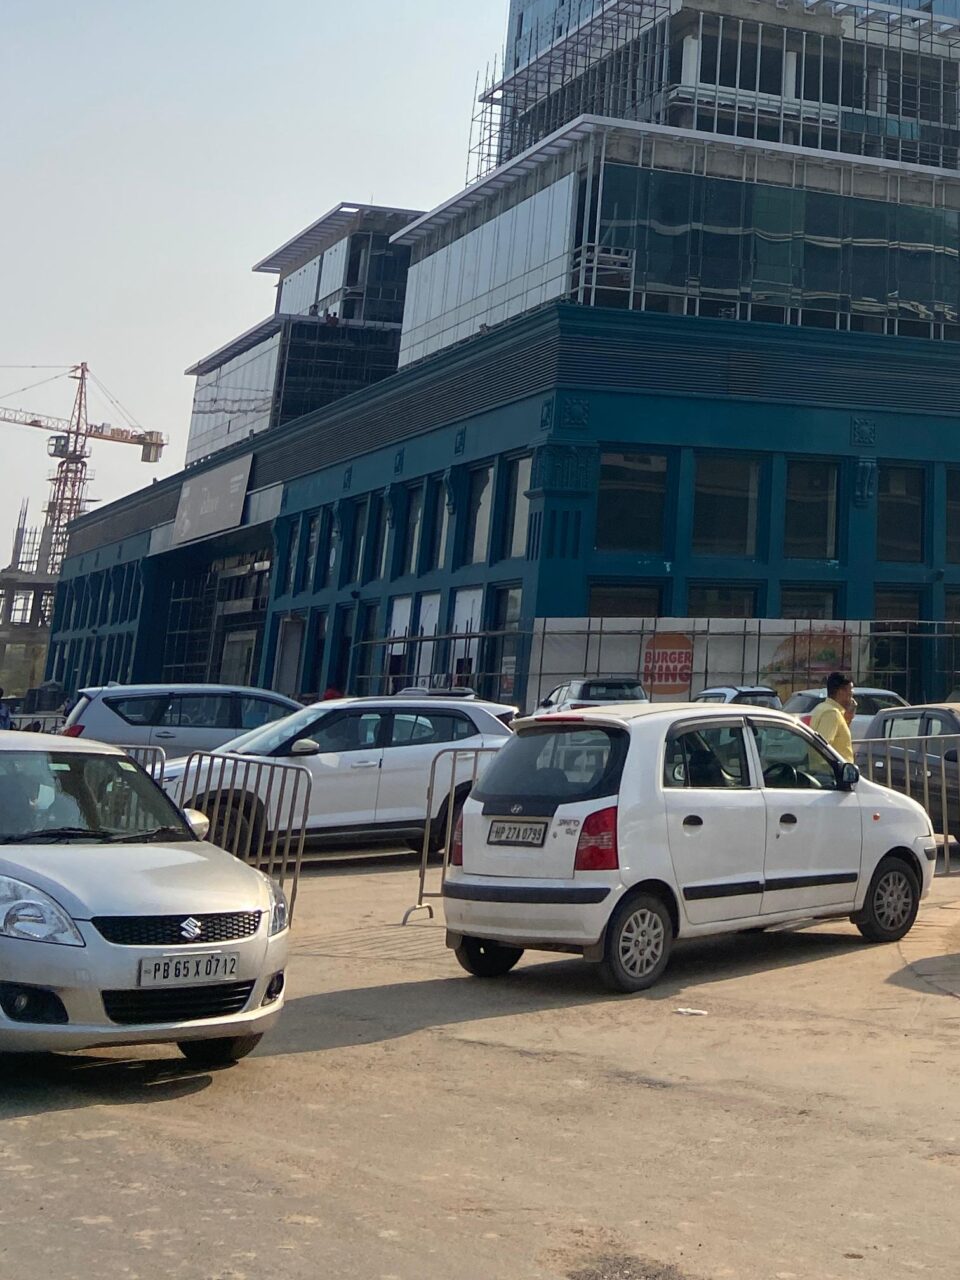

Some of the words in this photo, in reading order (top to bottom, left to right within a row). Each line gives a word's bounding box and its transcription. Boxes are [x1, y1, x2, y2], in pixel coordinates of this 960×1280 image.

[644, 651, 691, 664] BURGER
[643, 664, 691, 683] KING
[153, 962, 170, 979] PB
[174, 960, 190, 977] 65
[194, 959, 201, 976] X
[205, 957, 236, 975] 0712
